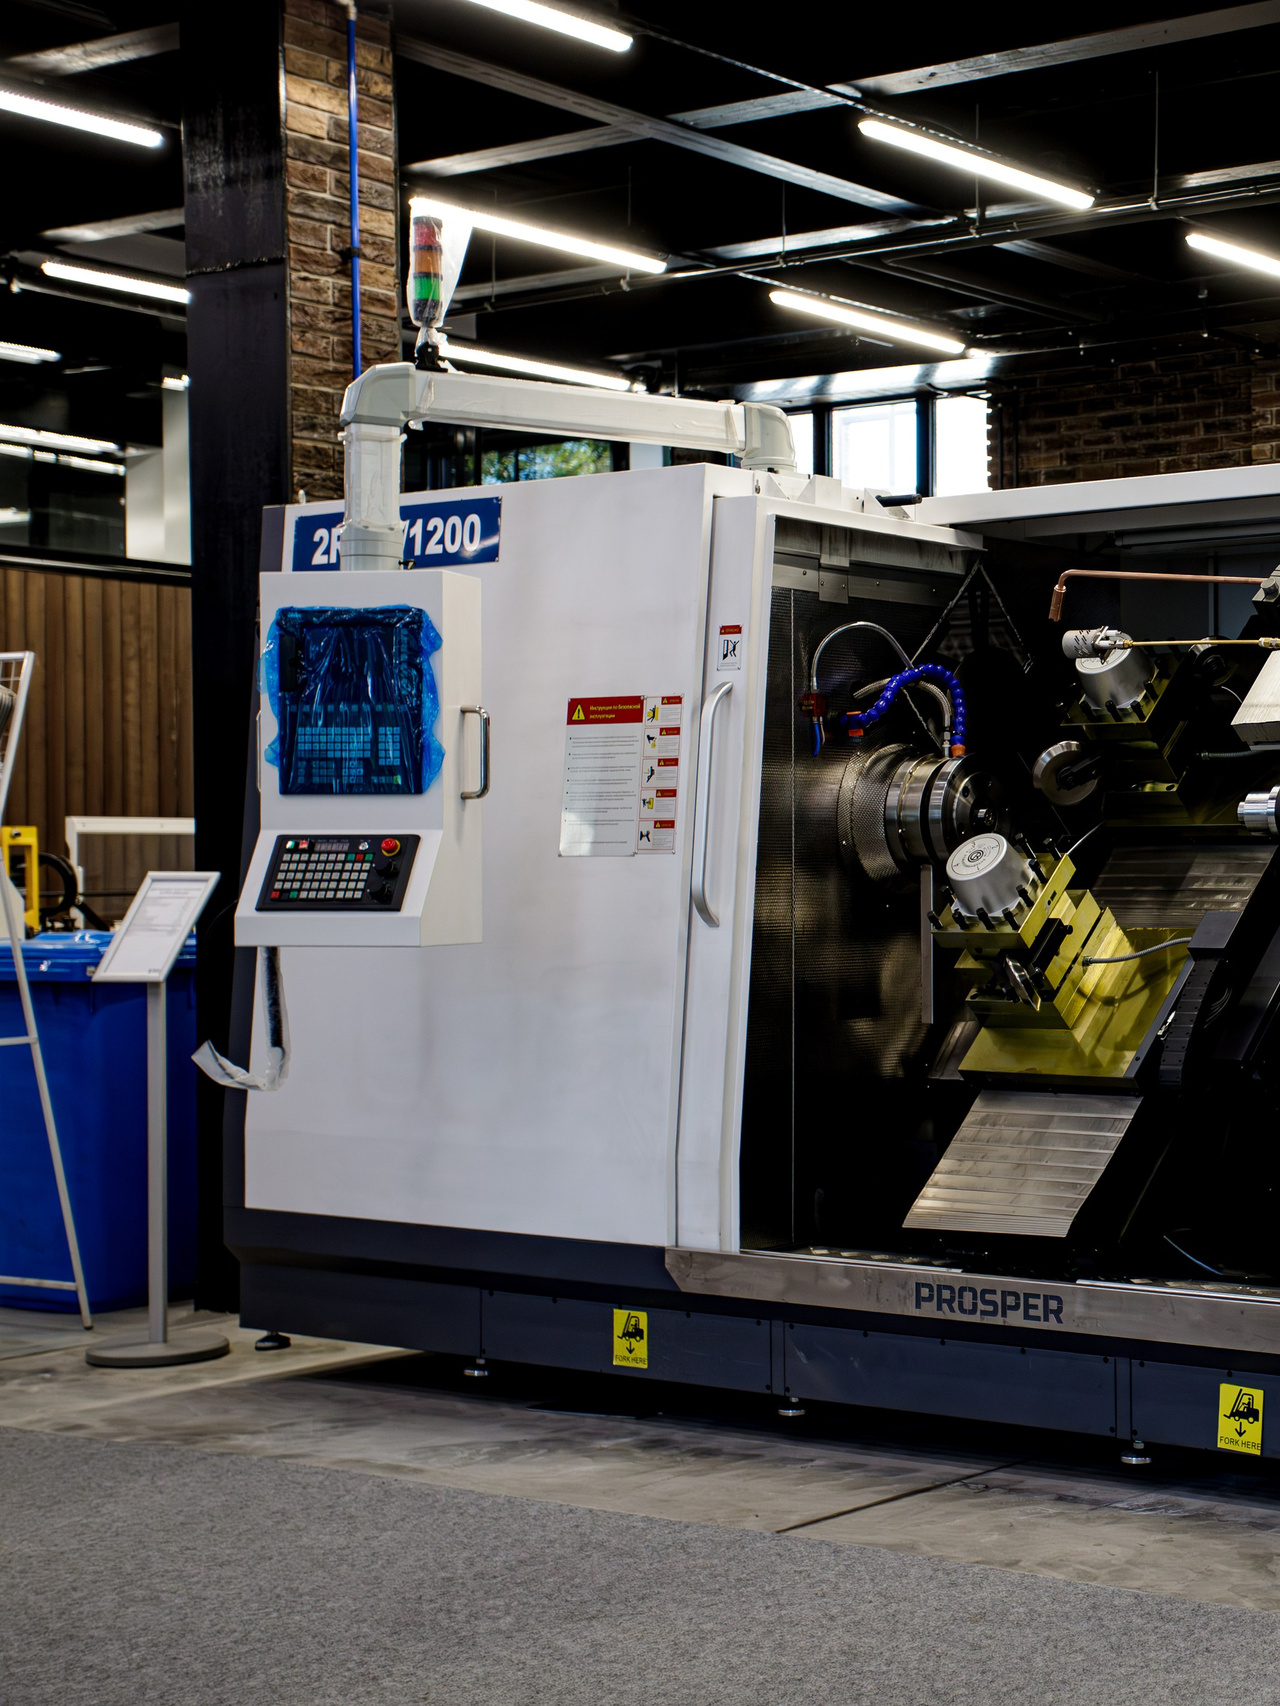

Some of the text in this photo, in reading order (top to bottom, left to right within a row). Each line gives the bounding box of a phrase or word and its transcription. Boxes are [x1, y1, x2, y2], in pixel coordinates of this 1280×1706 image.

[915, 1282, 1064, 1324] PROSPER
[616, 1354, 647, 1365] FORK HERE
[1220, 1436, 1261, 1450] FORK HERE
